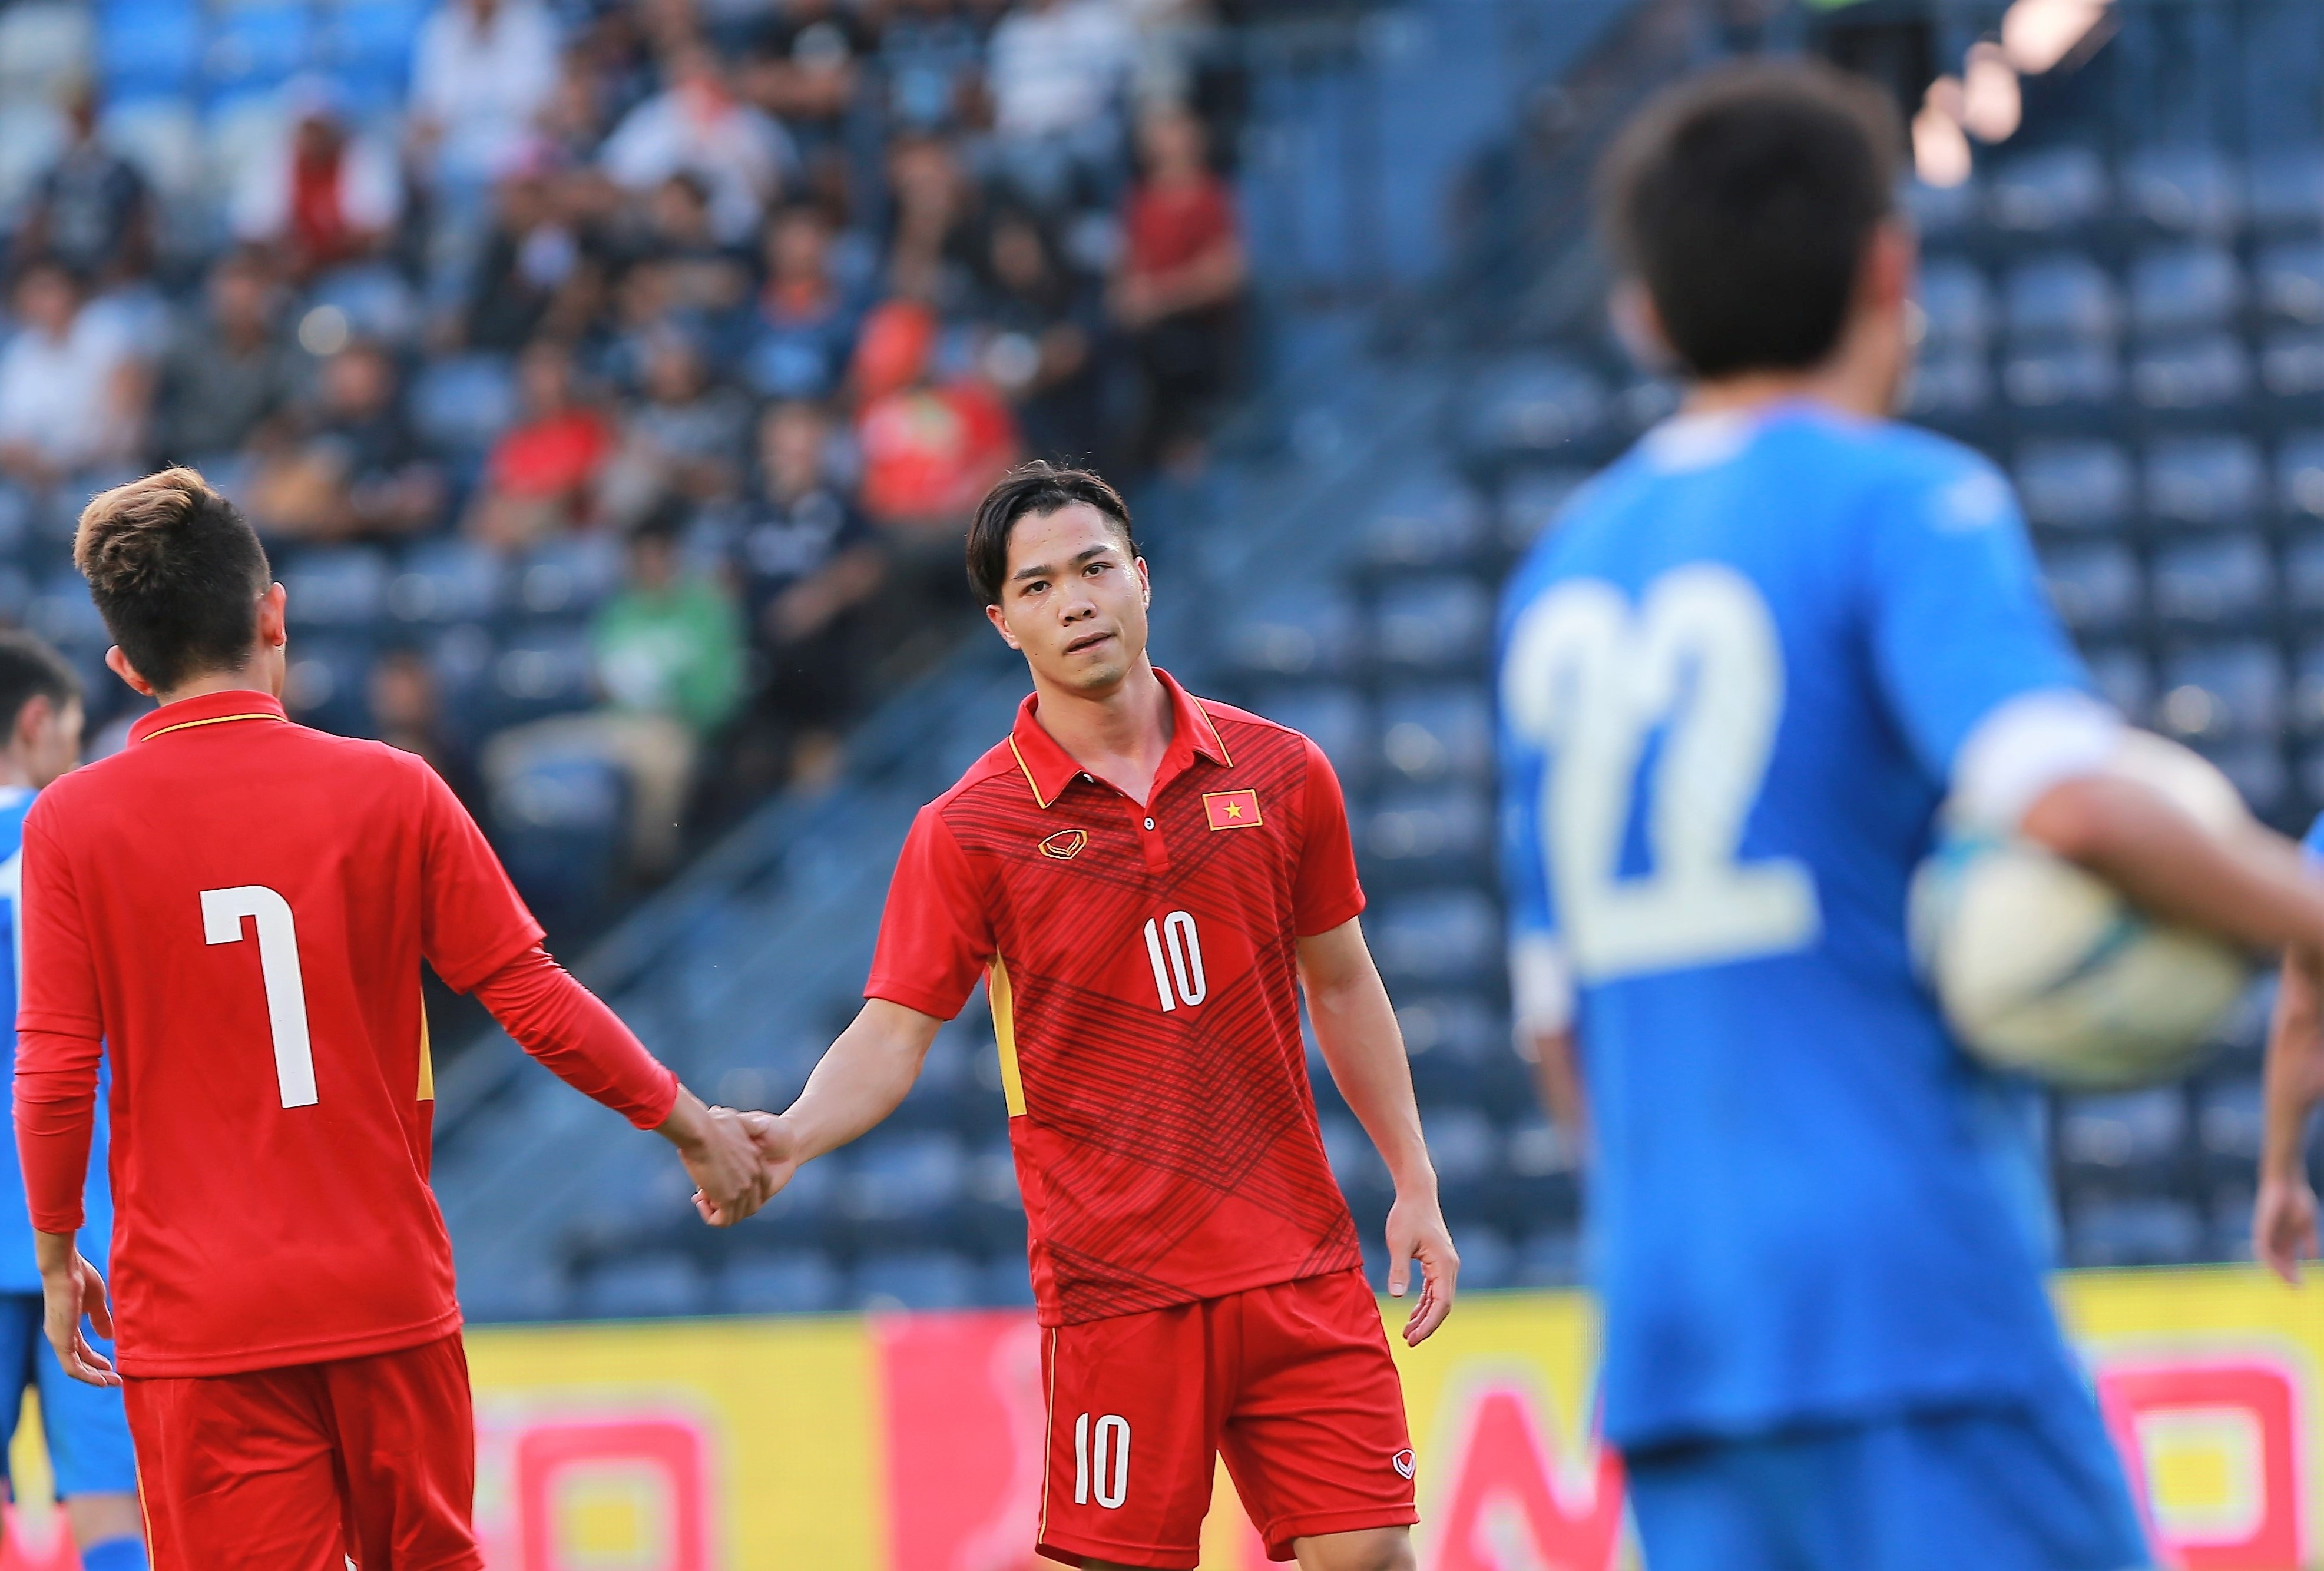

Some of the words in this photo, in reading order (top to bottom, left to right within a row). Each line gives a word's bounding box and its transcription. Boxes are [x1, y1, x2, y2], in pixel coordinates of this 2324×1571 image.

[1503, 562, 1820, 983] 22
[199, 884, 319, 1109] 7
[1143, 910, 1207, 1013] 10
[1074, 1412, 1131, 1510] 10
